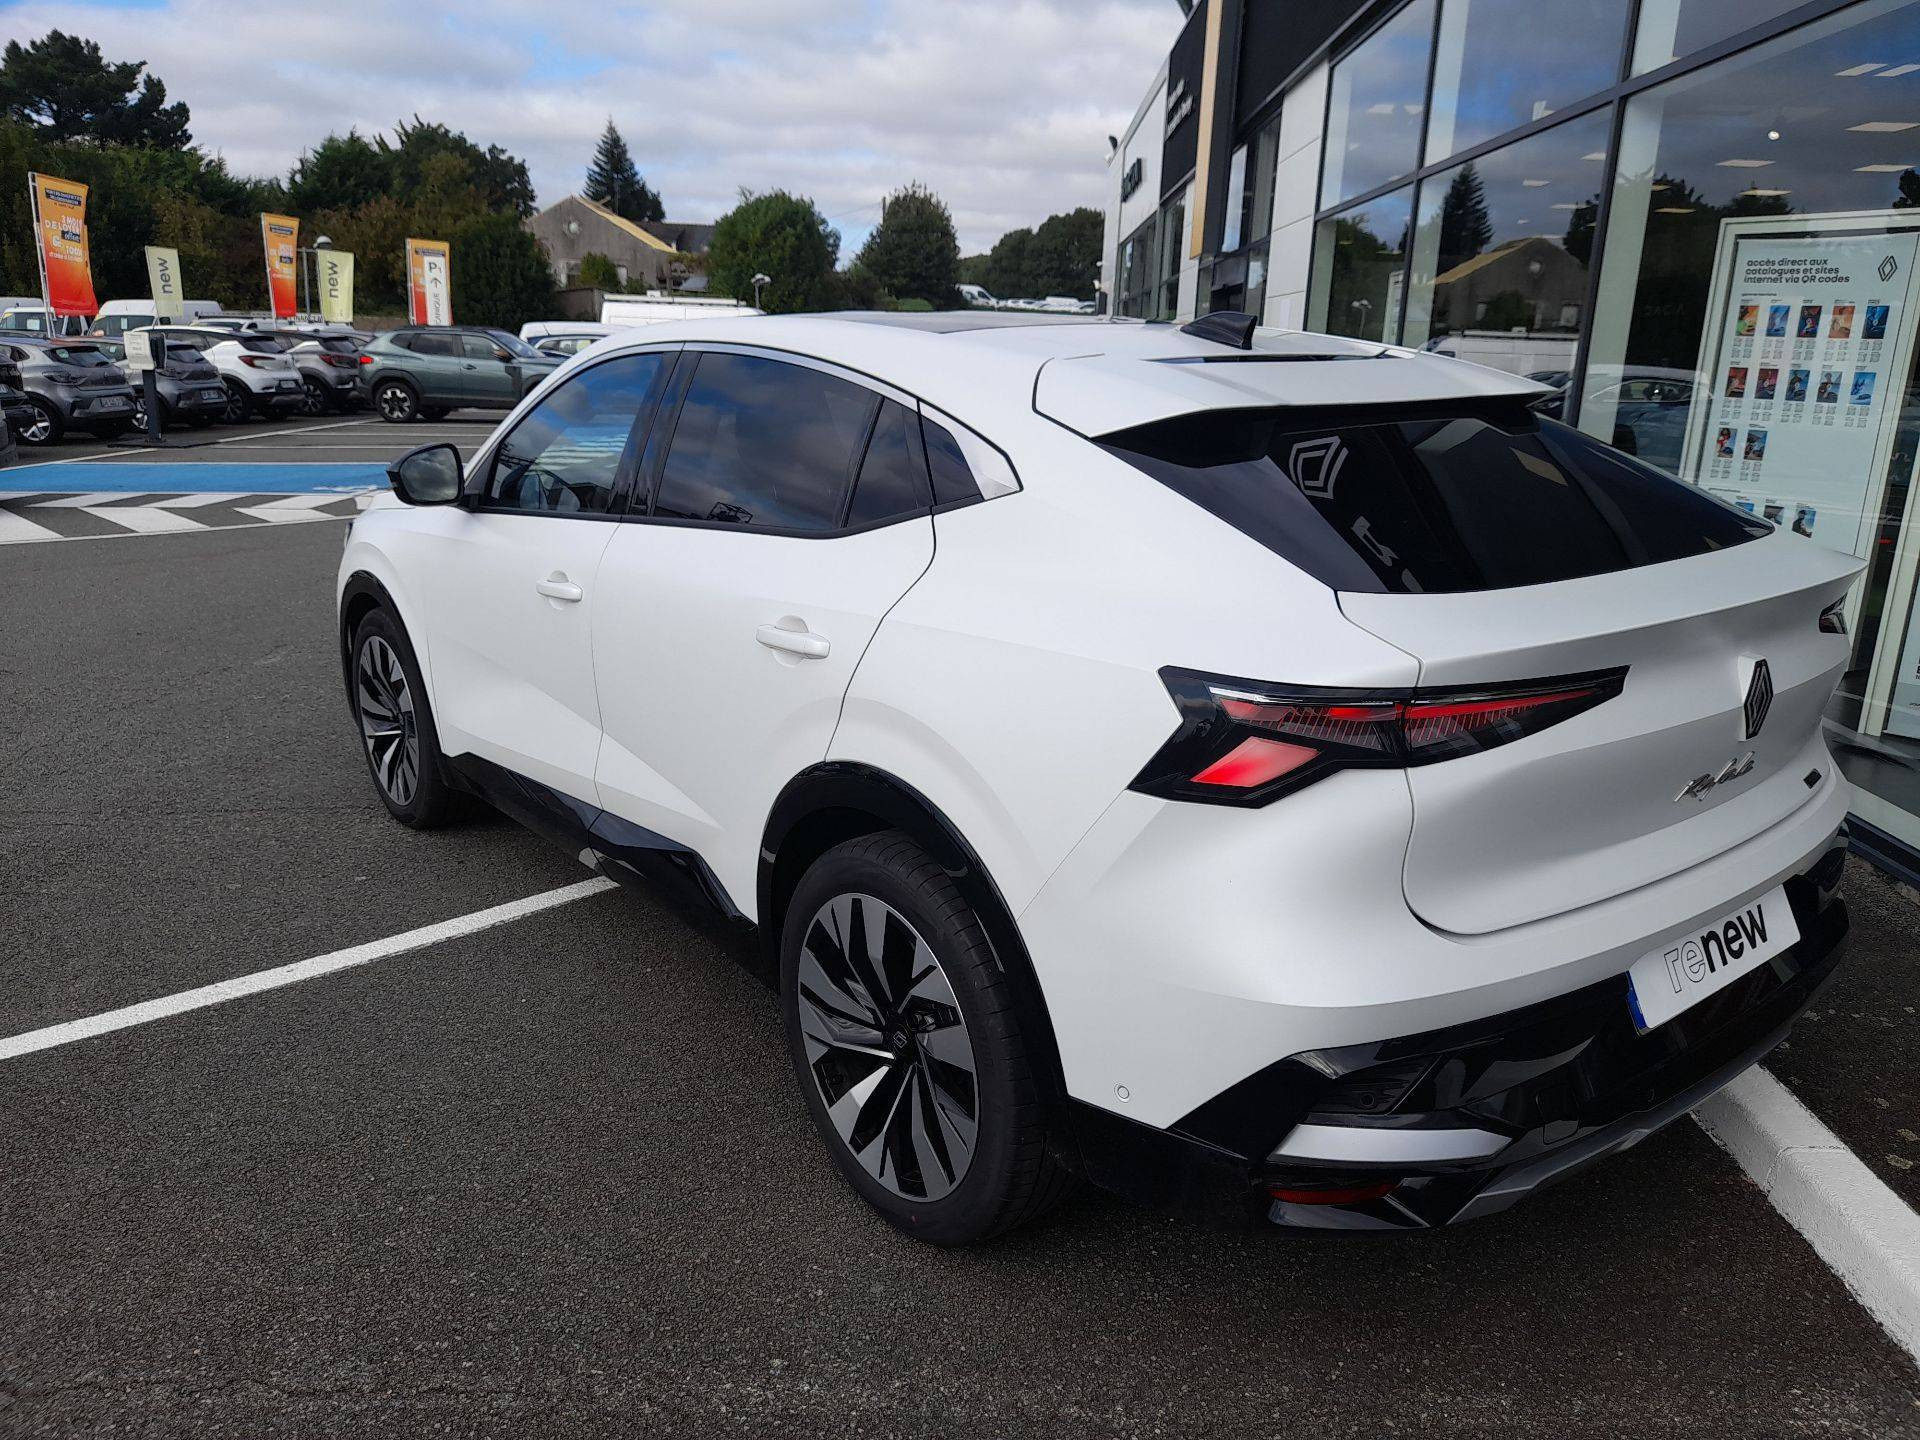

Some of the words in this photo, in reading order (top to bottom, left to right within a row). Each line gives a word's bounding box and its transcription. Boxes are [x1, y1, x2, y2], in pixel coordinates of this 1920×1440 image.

[1745, 266, 1801, 276] catalogues
[1802, 267, 1814, 275] et
[1815, 266, 1840, 275] sites
[1747, 258, 1776, 267] accès
[1778, 257, 1808, 266] direct
[1809, 258, 1829, 266] aux
[157, 257, 173, 294] new
[327, 260, 339, 299] new
[1744, 275, 1784, 283] internet
[1785, 275, 1800, 283] via
[1801, 275, 1816, 283] QR
[1818, 274, 1850, 283] codes
[1663, 903, 1768, 994] renew
